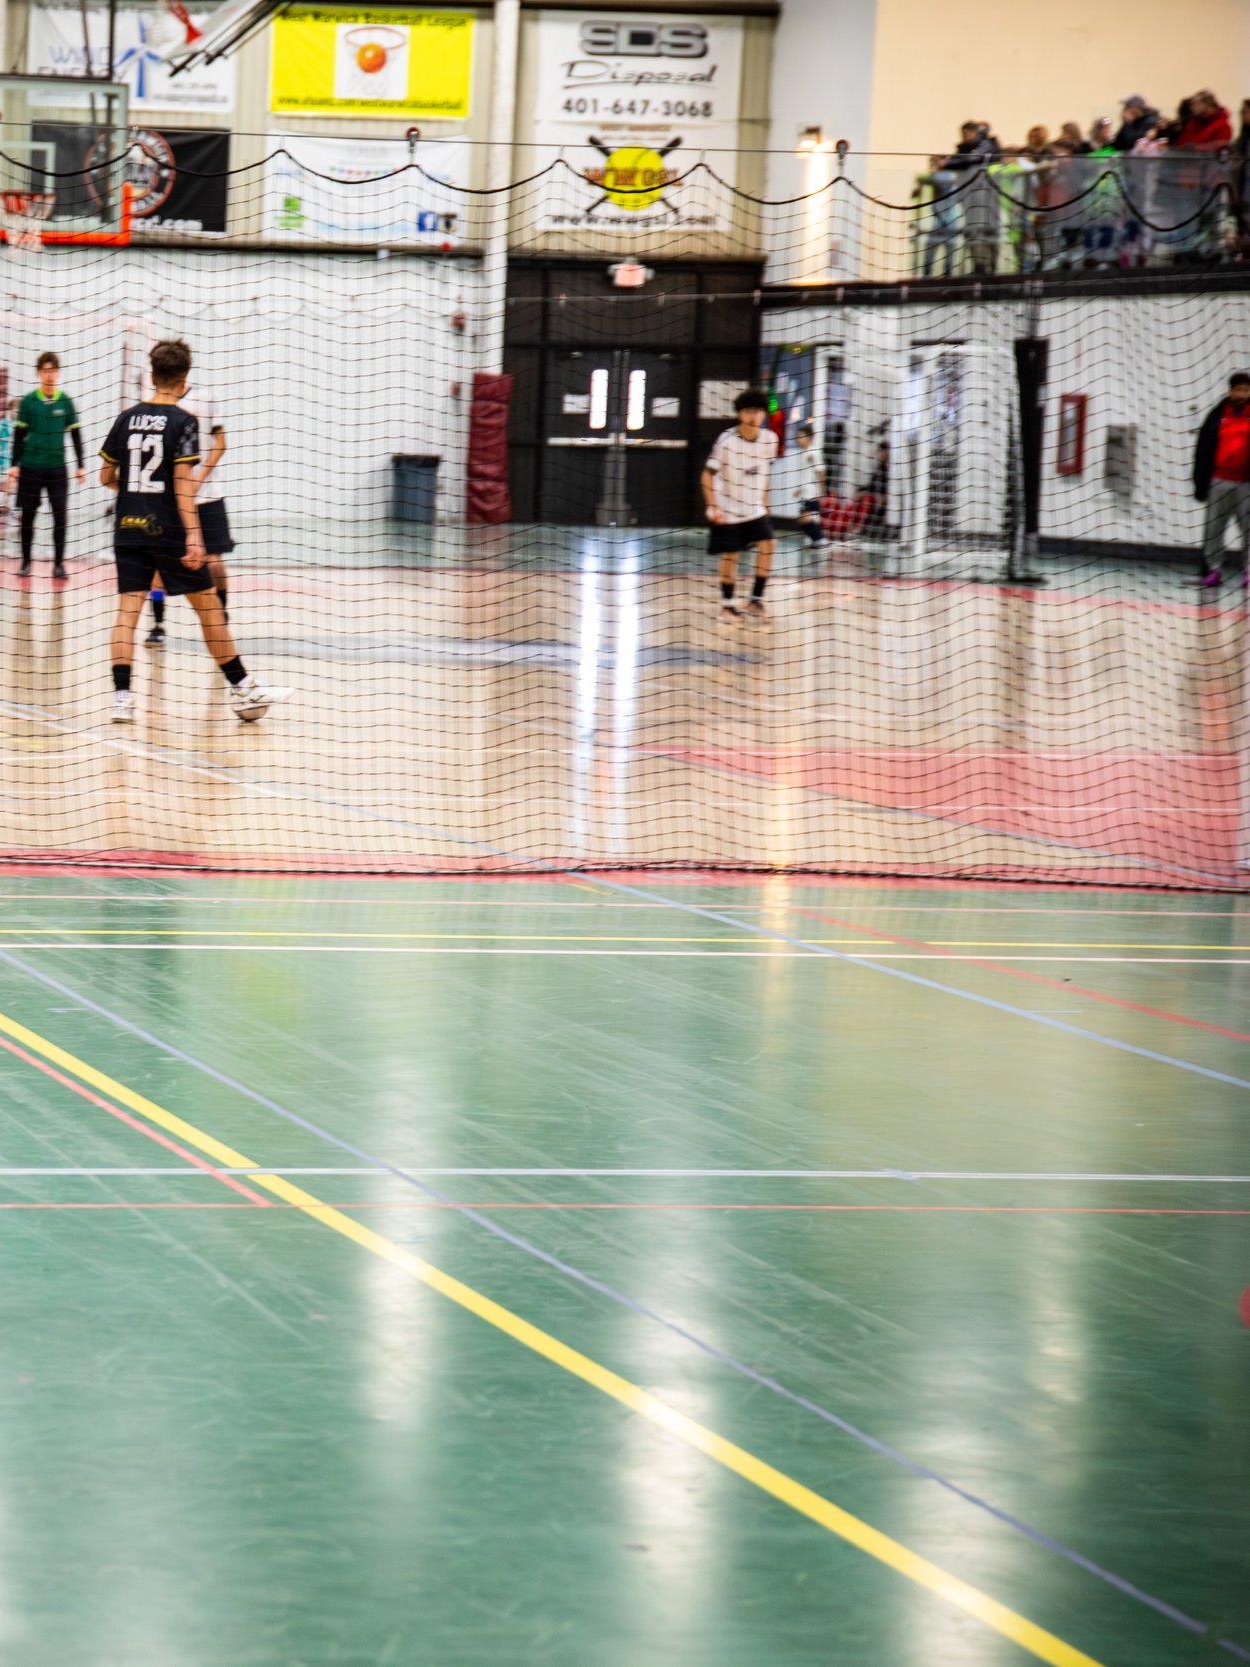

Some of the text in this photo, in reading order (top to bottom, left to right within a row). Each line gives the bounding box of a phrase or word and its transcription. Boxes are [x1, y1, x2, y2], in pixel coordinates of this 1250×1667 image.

[560, 60, 718, 85] Disposal
[562, 98, 713, 117] 401-647-3068
[128, 414, 168, 431] LUCAS
[127, 433, 165, 493] 12
